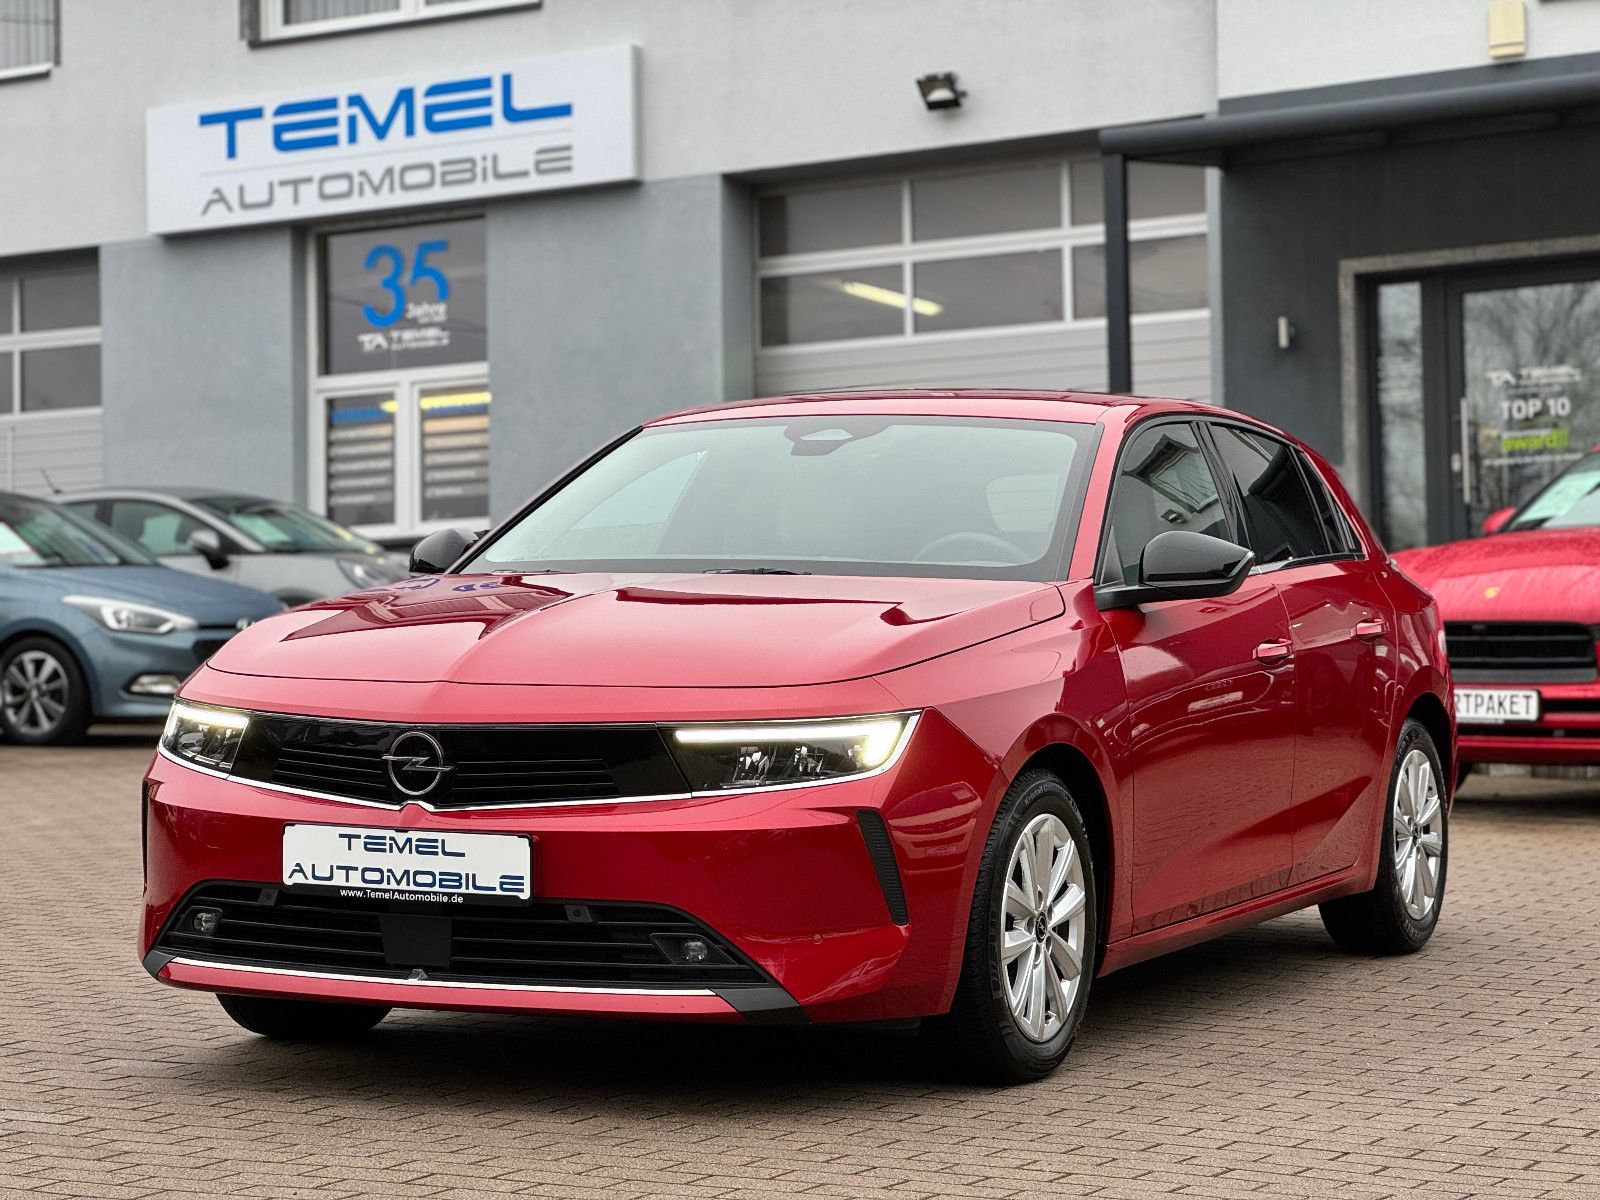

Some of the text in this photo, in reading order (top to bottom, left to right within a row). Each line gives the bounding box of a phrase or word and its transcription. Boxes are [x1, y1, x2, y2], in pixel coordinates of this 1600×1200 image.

[199, 73, 573, 160] TEMEL
[364, 240, 449, 328] 35
[1502, 396, 1571, 420] TOP 10
[338, 833, 466, 858] TEMEL
[288, 862, 525, 893] AUTOMOBILE
[339, 888, 464, 904] www.TemelAutomobile.de
